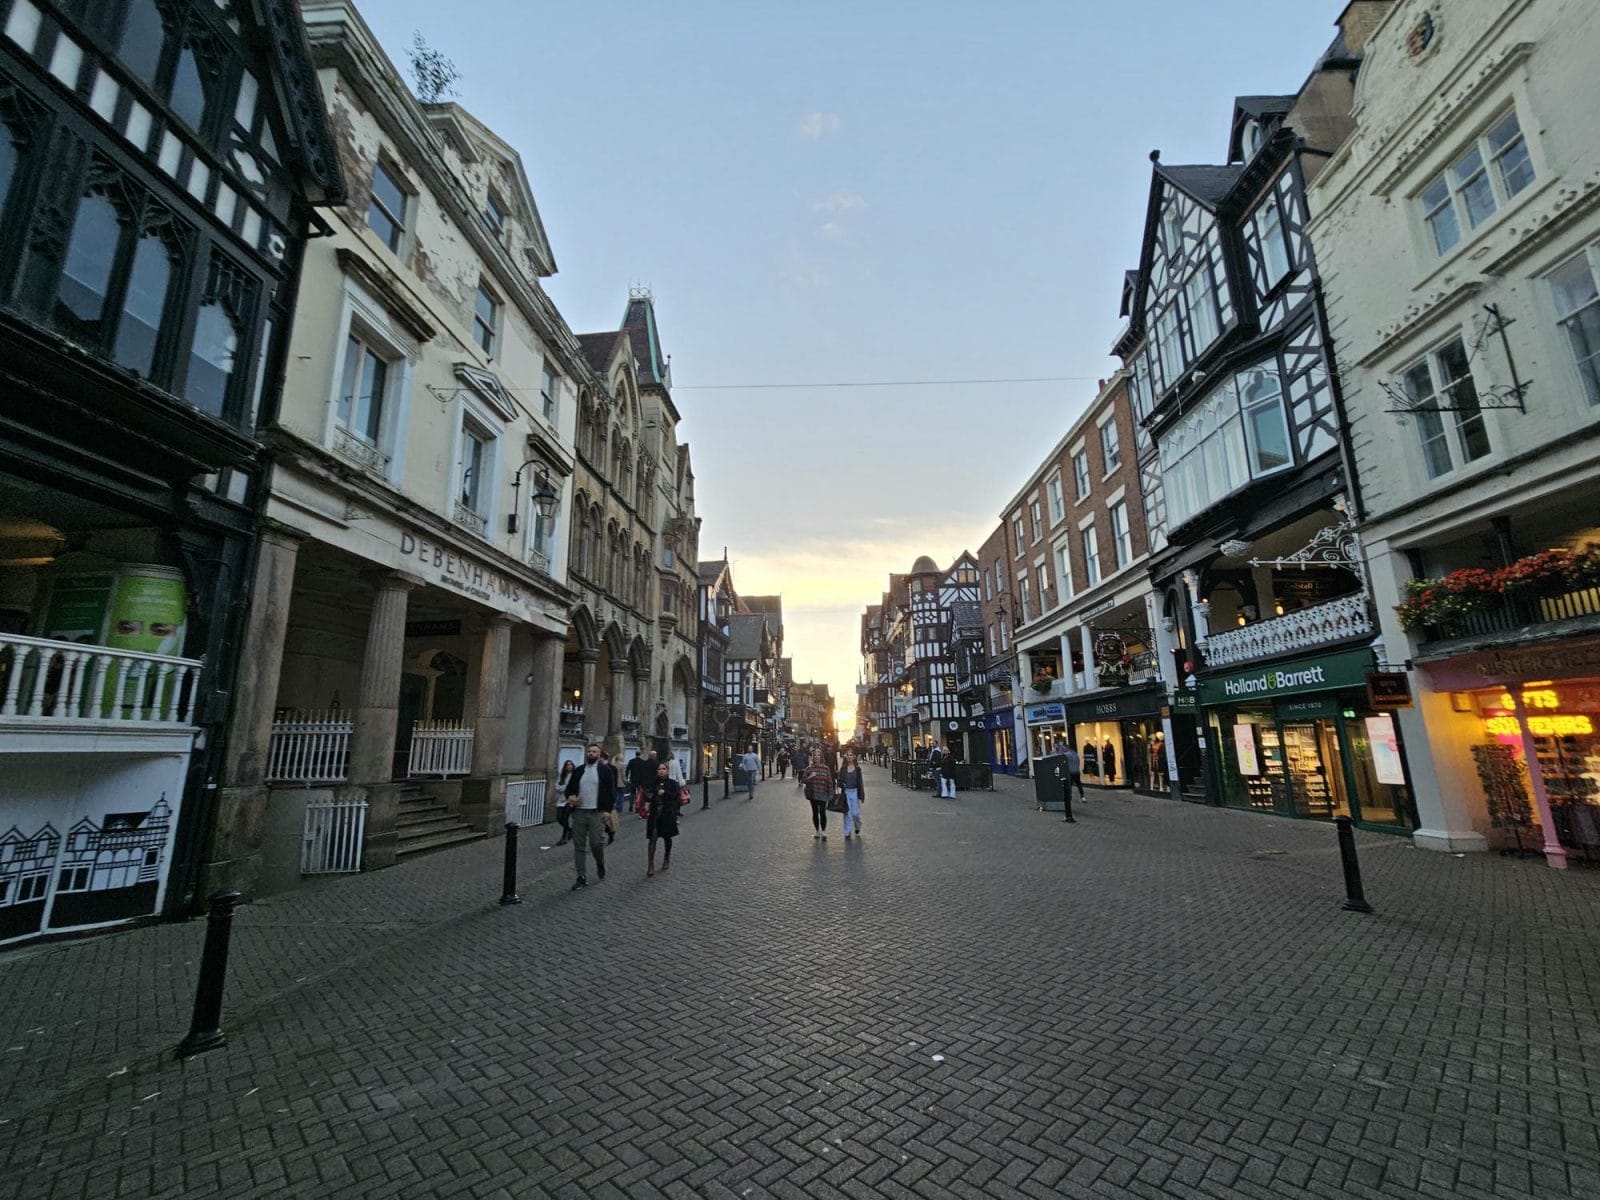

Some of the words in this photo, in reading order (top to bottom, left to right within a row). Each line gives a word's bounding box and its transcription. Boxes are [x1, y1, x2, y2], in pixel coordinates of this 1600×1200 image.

[400, 532, 520, 603] DEBENHAMS
[1096, 703, 1117, 714] HOBBS
[1289, 703, 1306, 711] SINCE
